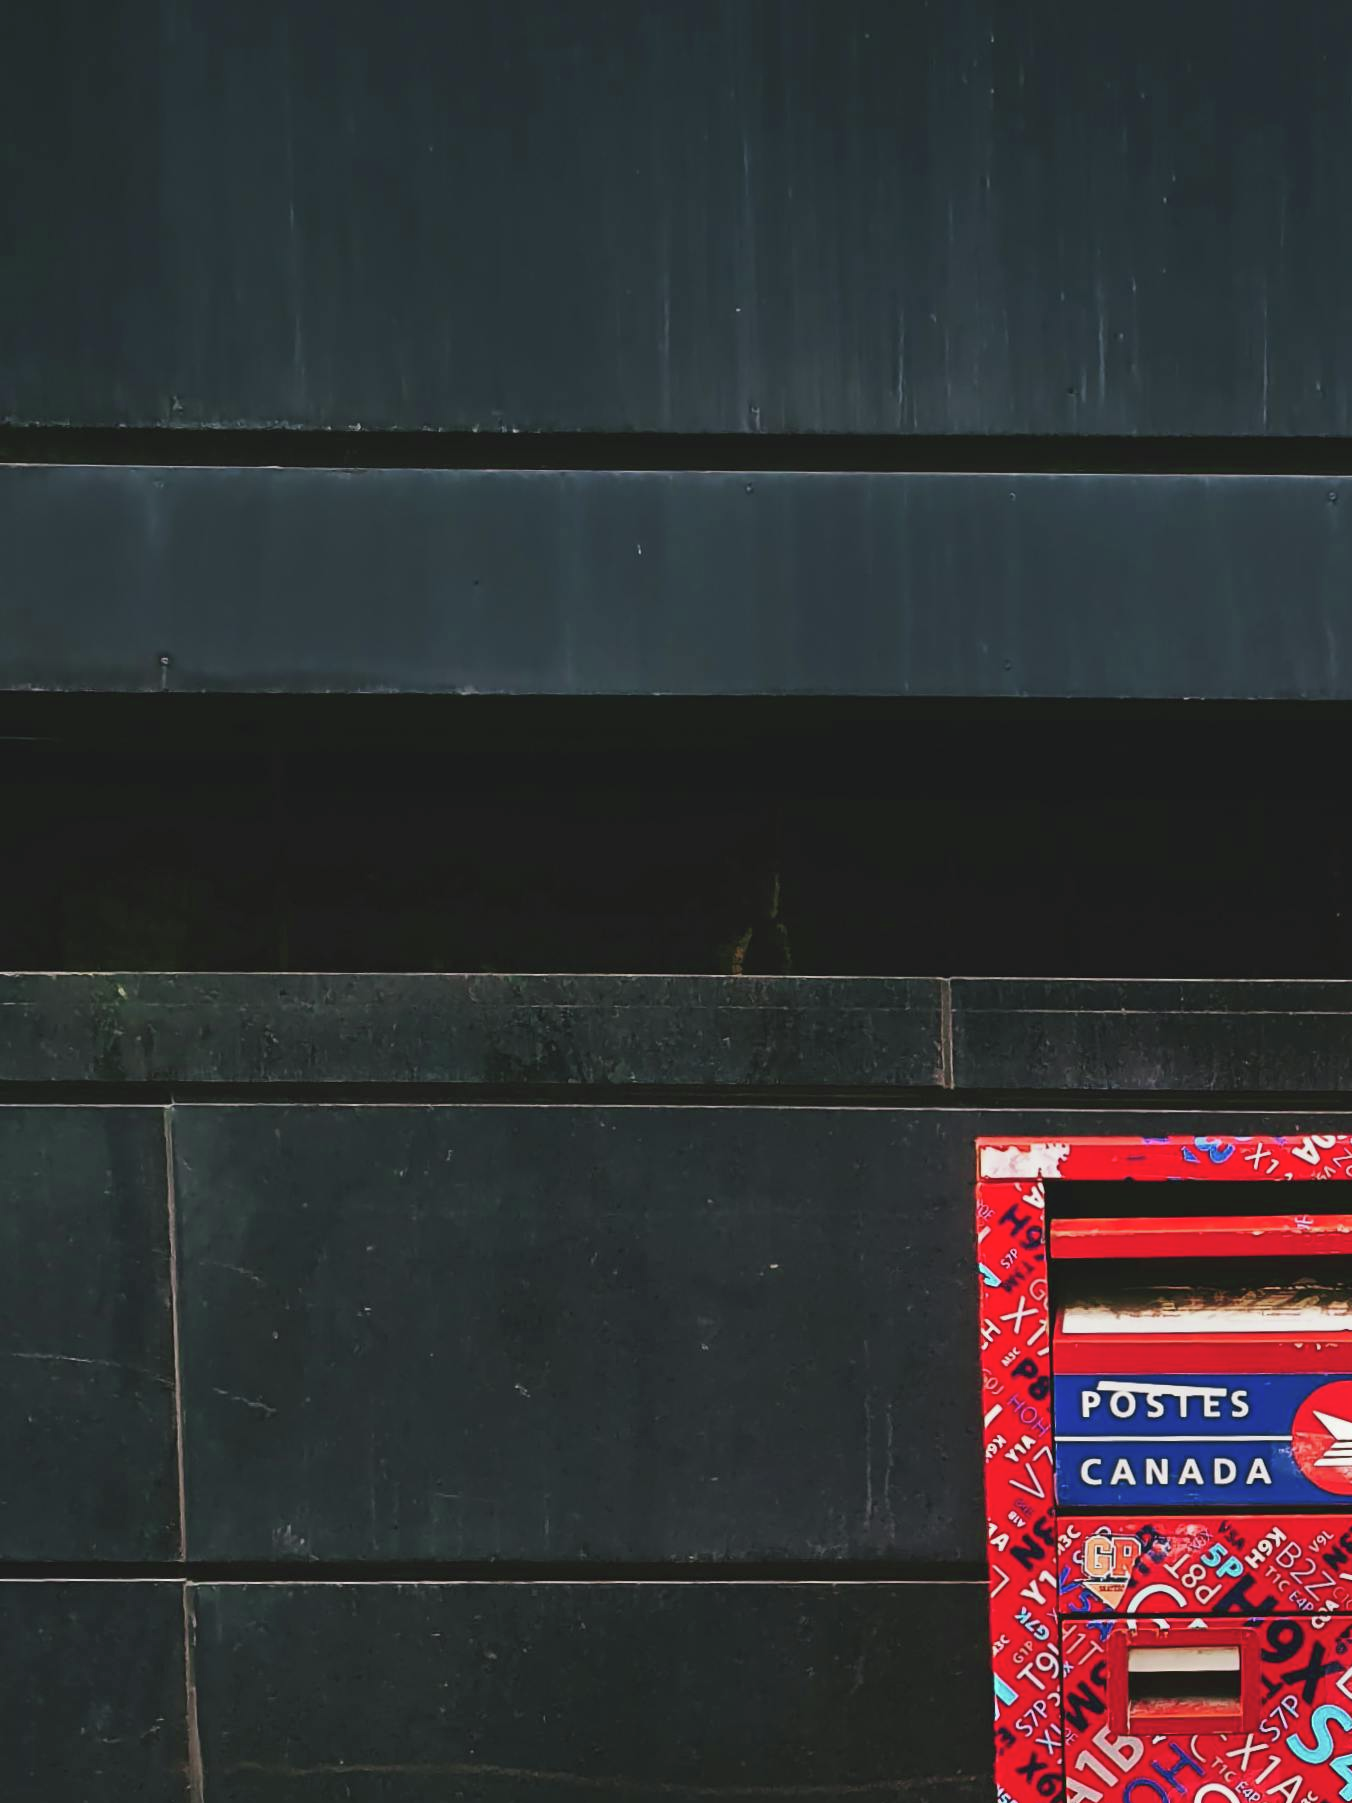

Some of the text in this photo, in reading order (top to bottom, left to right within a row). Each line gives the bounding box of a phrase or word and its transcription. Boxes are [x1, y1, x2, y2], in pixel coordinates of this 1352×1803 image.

[1081, 1390, 1249, 1417] POSTES
[1005, 1435, 1036, 1462] Y1A
[1080, 1458, 1272, 1485] CANADA
[1245, 1526, 1287, 1568] K6H
[1309, 1530, 1334, 1553] V9L
[1163, 1553, 1222, 1605] P8T
[1265, 1565, 1290, 1592] T1C
[1276, 1541, 1336, 1601] B2Z
[1289, 1591, 1314, 1612] E4P
[1014, 1606, 1050, 1640] G7K
[1211, 1573, 1344, 1704] H9X
[1016, 1700, 1047, 1737] S7P
[1259, 1694, 1300, 1742] S7P
[1211, 1756, 1236, 1783] T1C
[1234, 1781, 1261, 1803] E4P
